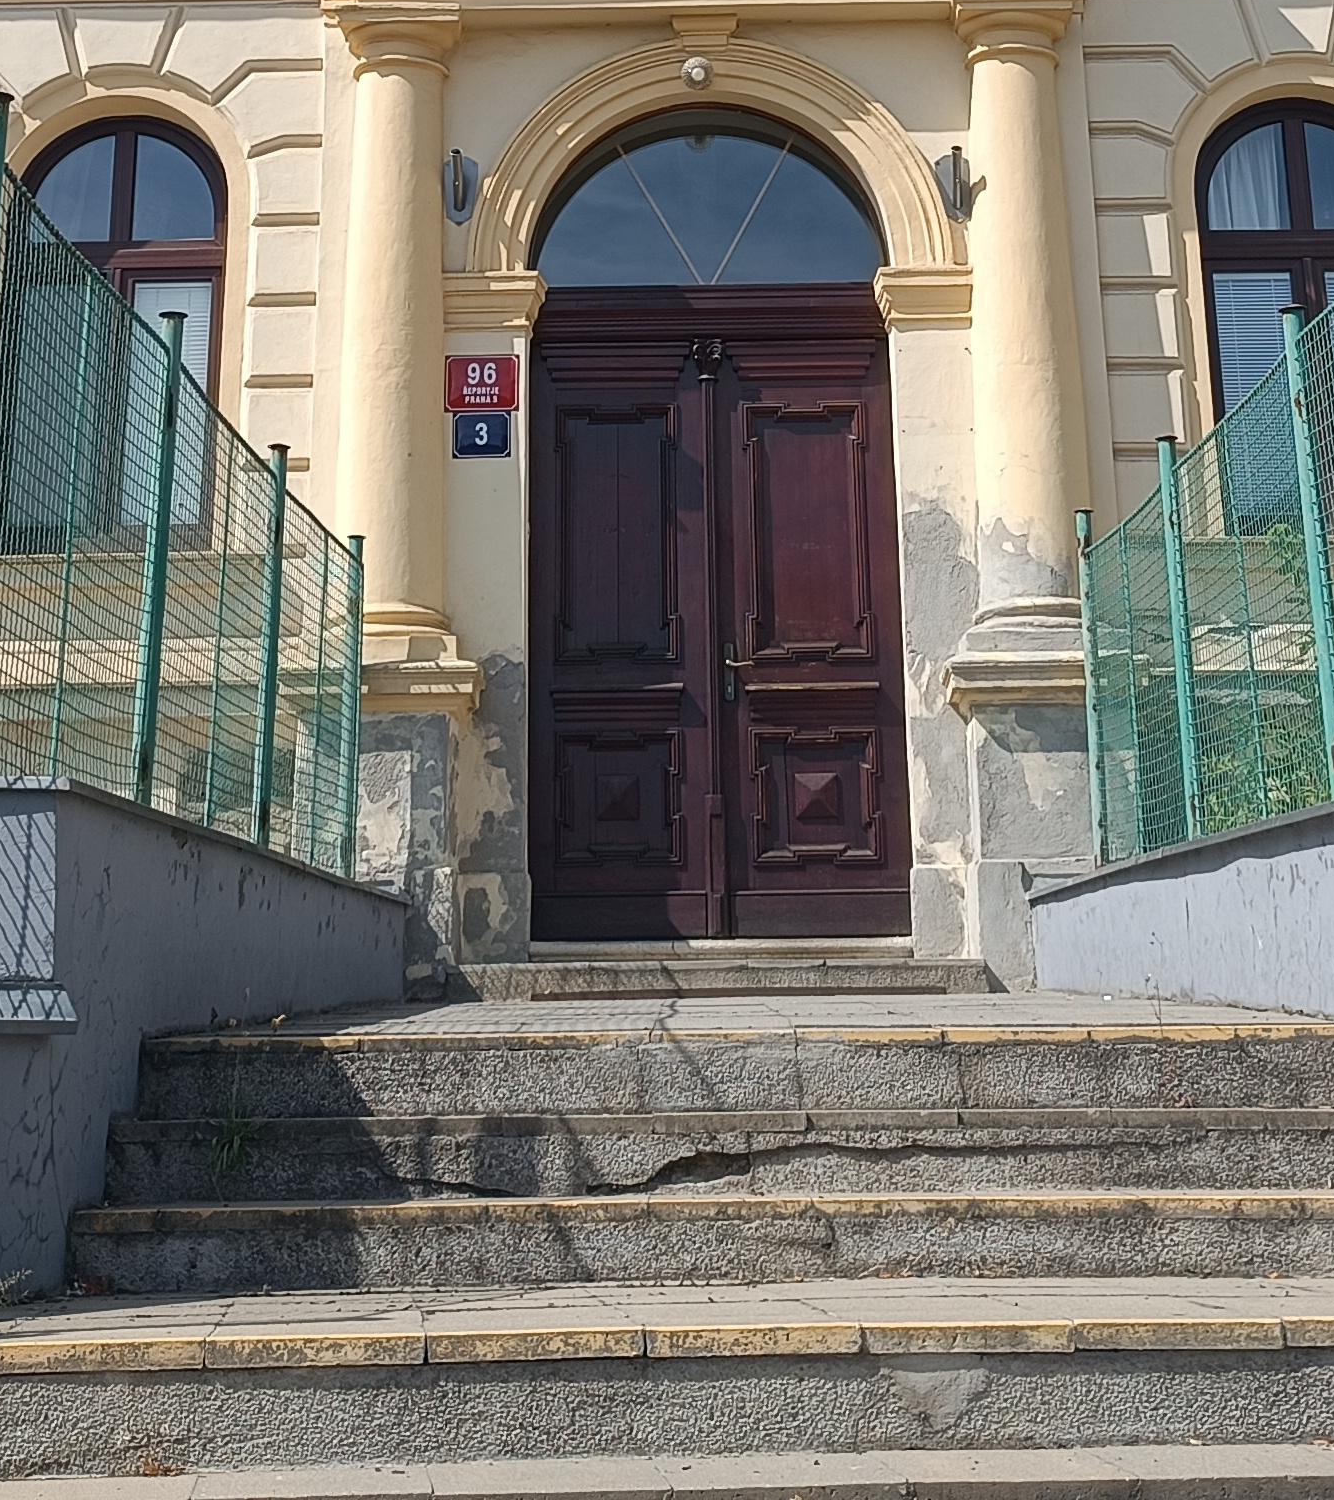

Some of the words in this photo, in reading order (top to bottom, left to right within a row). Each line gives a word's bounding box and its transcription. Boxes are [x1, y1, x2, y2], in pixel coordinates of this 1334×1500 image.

[467, 362, 497, 385] 96
[464, 395, 491, 404] PRAHA
[474, 422, 488, 446] 3
